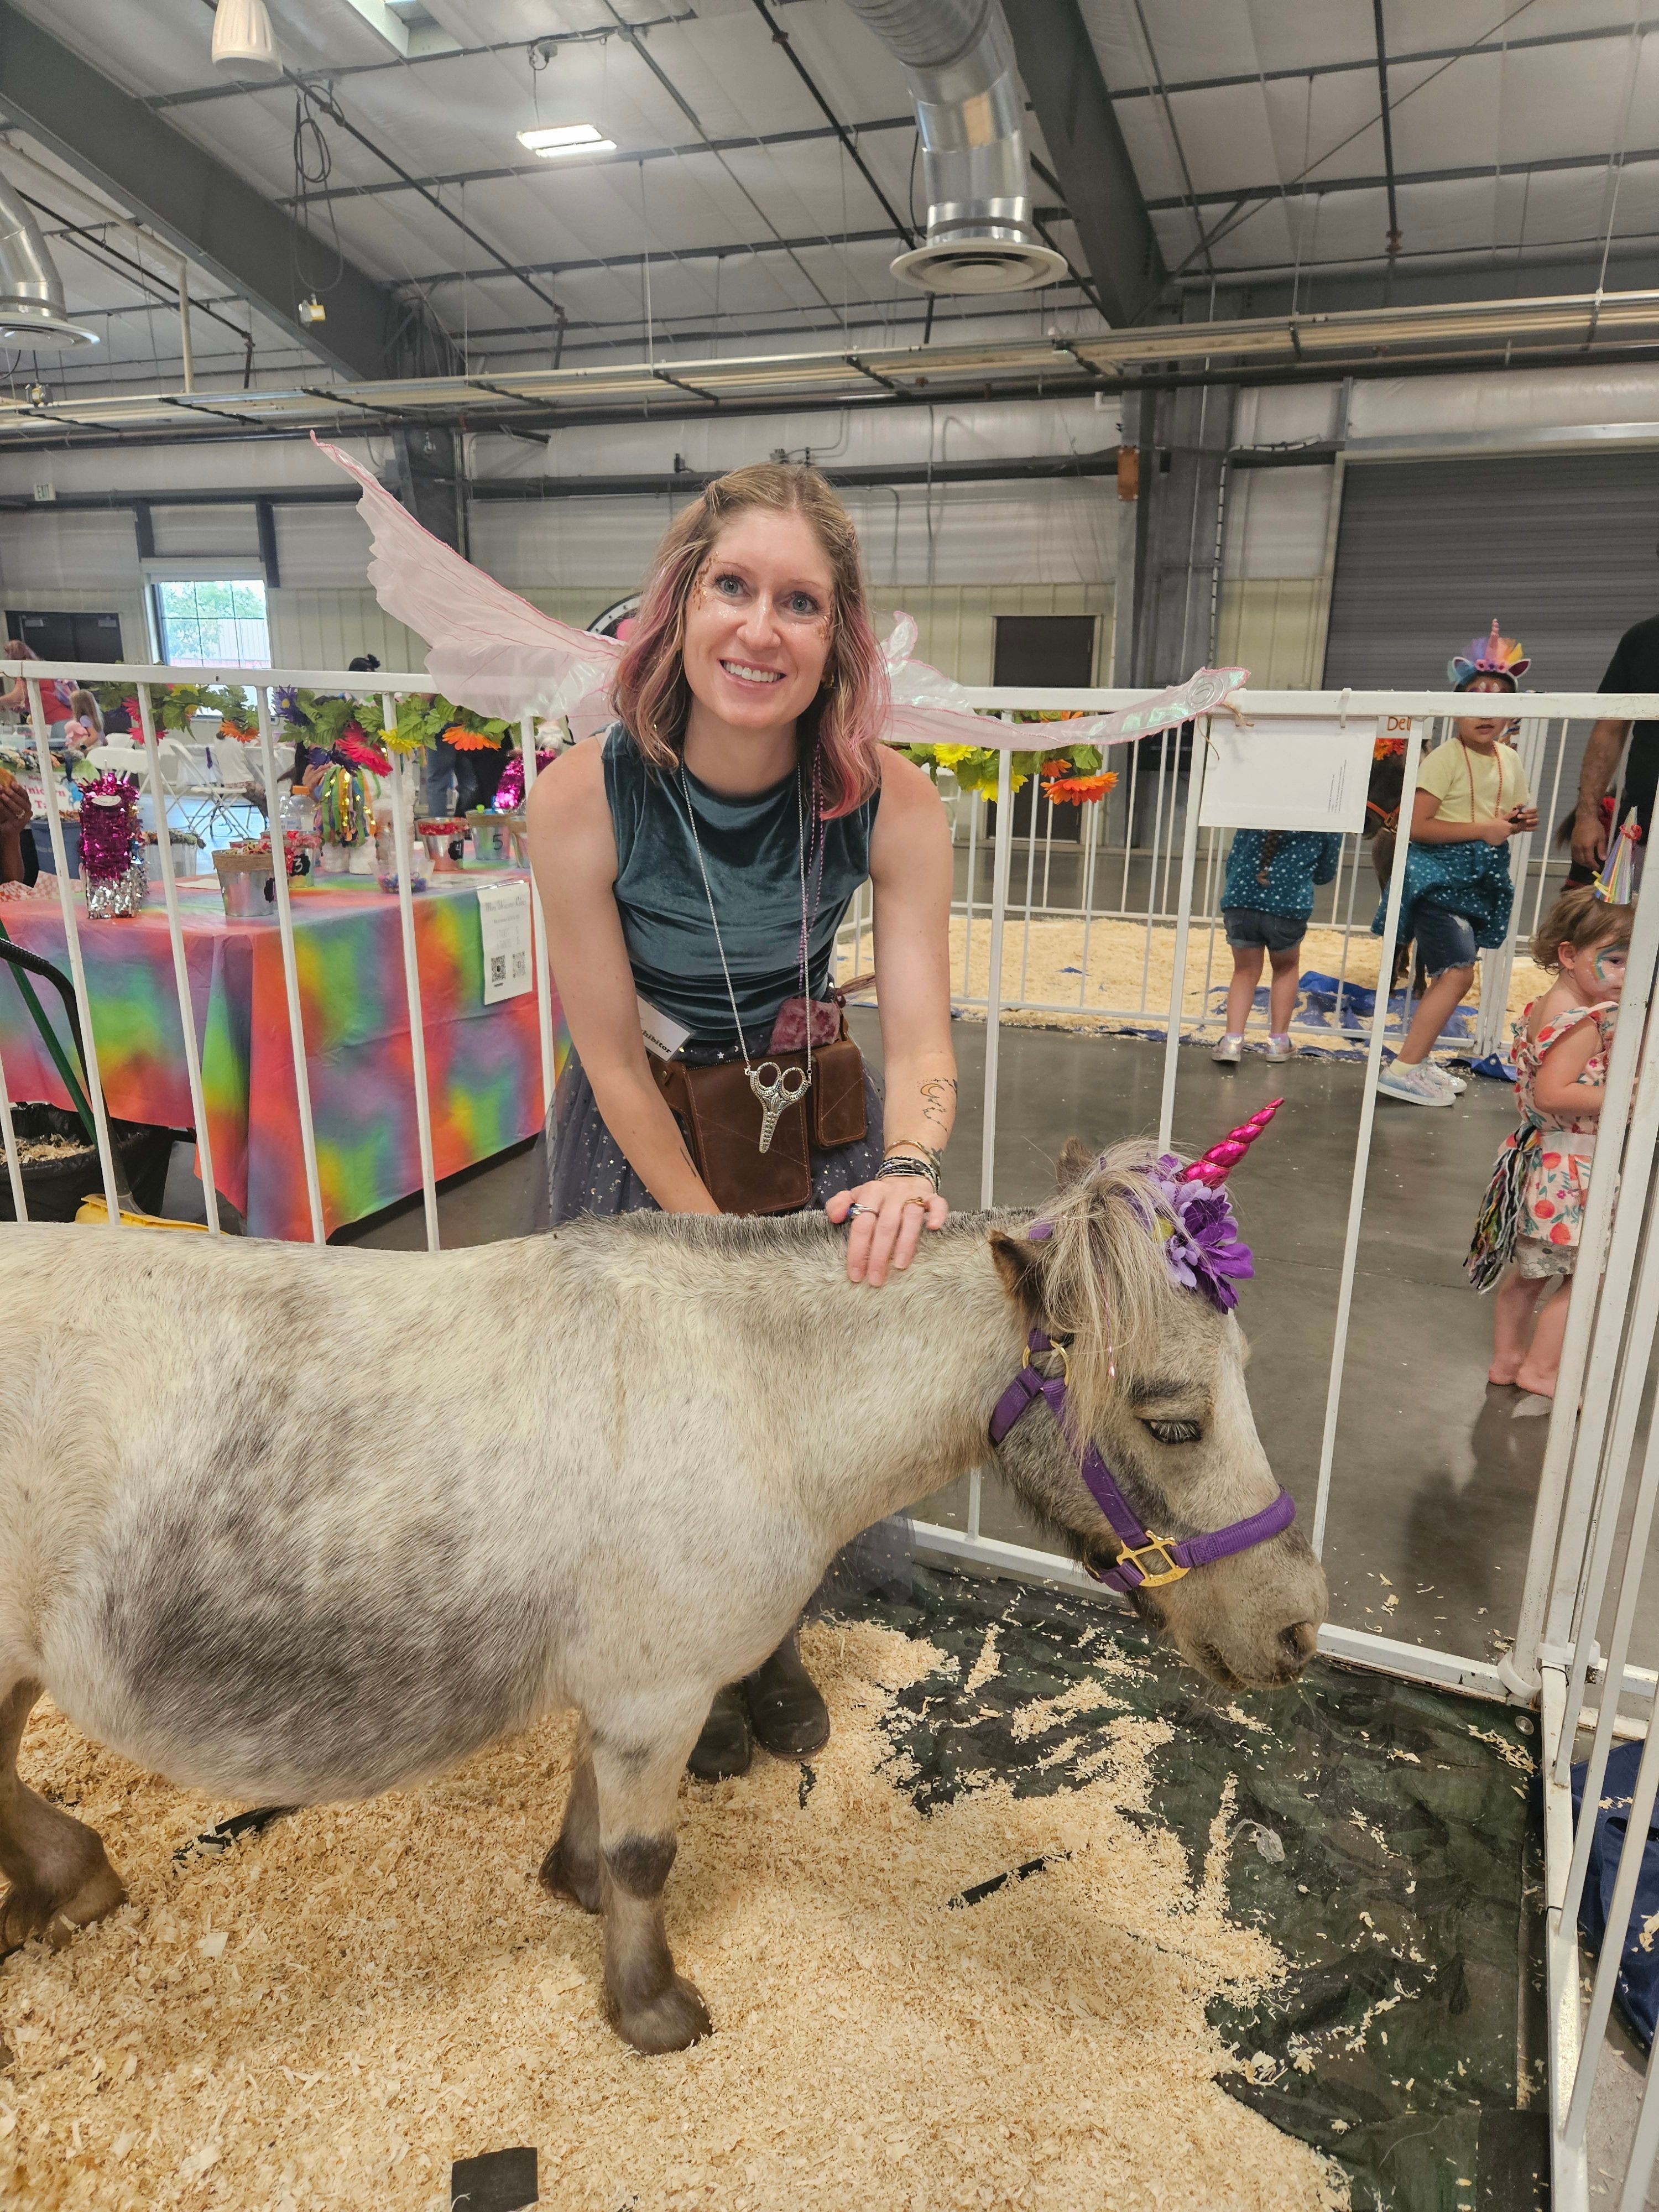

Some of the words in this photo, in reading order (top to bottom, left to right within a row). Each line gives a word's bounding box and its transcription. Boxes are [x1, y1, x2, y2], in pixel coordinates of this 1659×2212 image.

[456, 843, 462, 855] 4
[493, 834, 503, 851] 5
[293, 857, 303, 873] 3
[641, 1029, 672, 1053] hibitor
